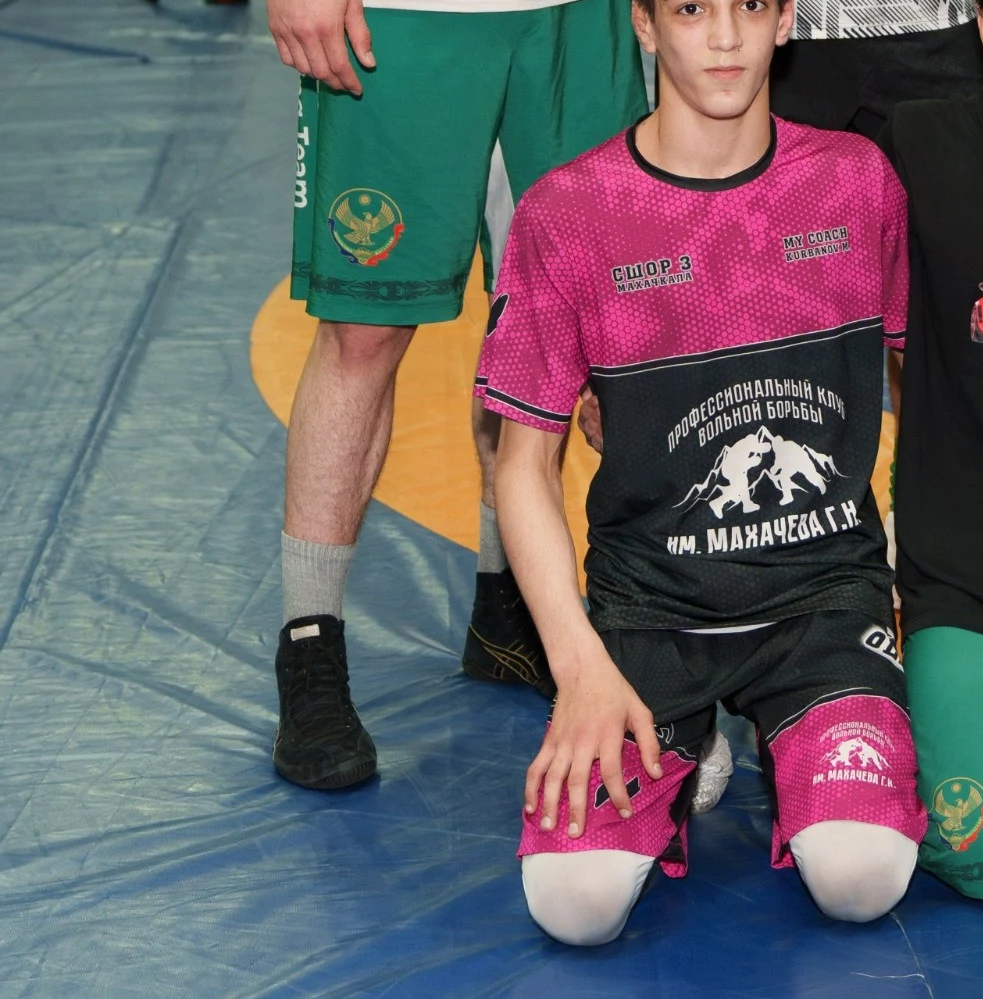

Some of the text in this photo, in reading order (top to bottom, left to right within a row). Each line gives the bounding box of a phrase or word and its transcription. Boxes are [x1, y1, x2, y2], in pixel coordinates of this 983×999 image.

[783, 227, 848, 249] MY COACH
[785, 244, 839, 262] KURBANOV
[611, 254, 692, 283] СШОР 3
[616, 272, 694, 294] МАХАЧКАЛА
[667, 378, 813, 453] ПРОФЕССИОНАЛЬНЫЙ
[698, 400, 823, 447] ВОЛЬНОЙ БОРЬБЫ
[706, 509, 826, 554] МАХАЧЕВА
[828, 769, 879, 785] МАХАЧЕВА
